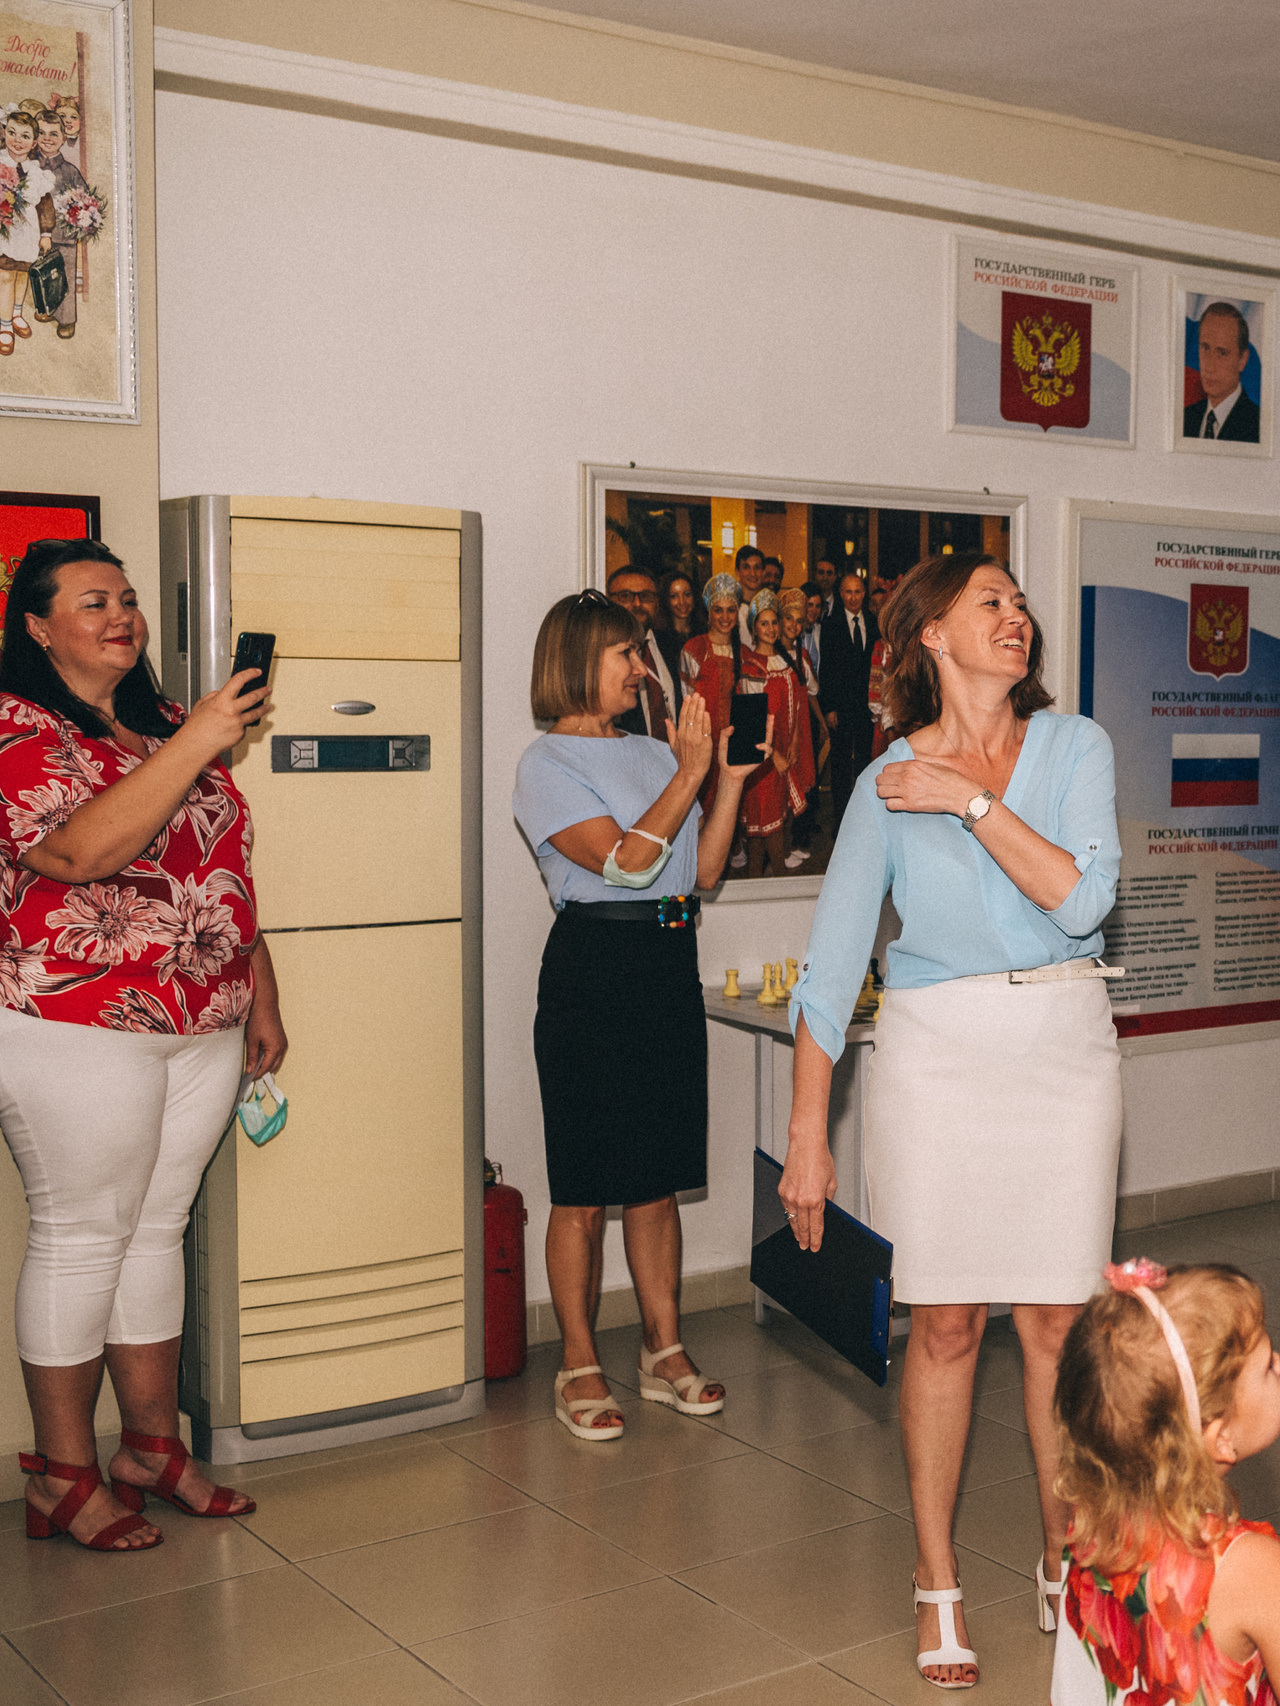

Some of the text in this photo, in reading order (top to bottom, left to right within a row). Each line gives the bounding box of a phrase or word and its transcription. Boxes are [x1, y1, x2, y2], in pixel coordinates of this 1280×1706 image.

[4, 35, 50, 62] Добро
[974, 257, 1116, 289] ГОСУДАРСТВЕННЫЙ ГЕРБ
[974, 271, 1119, 303] РОССИЙСКОЙ ФЕДЕРАЦИИ
[1156, 541, 1257, 559] ГОСУДАРСТВЕННЫЙ
[1154, 557, 1224, 572] РОССИЙСКОЙ
[1152, 690, 1280, 703] ГОСУДАРСТВЕННЫЙ ФЛАГ
[1151, 705, 1280, 718] РОССИЙСКОЙ ФЕДЕРАЦИИ
[1148, 824, 1279, 840] ГОСУДАРСТВЕННЫЙ ГИМН
[1148, 839, 1278, 855] РОССИЙСКОЙ ФЕДЕРАЦИИ
